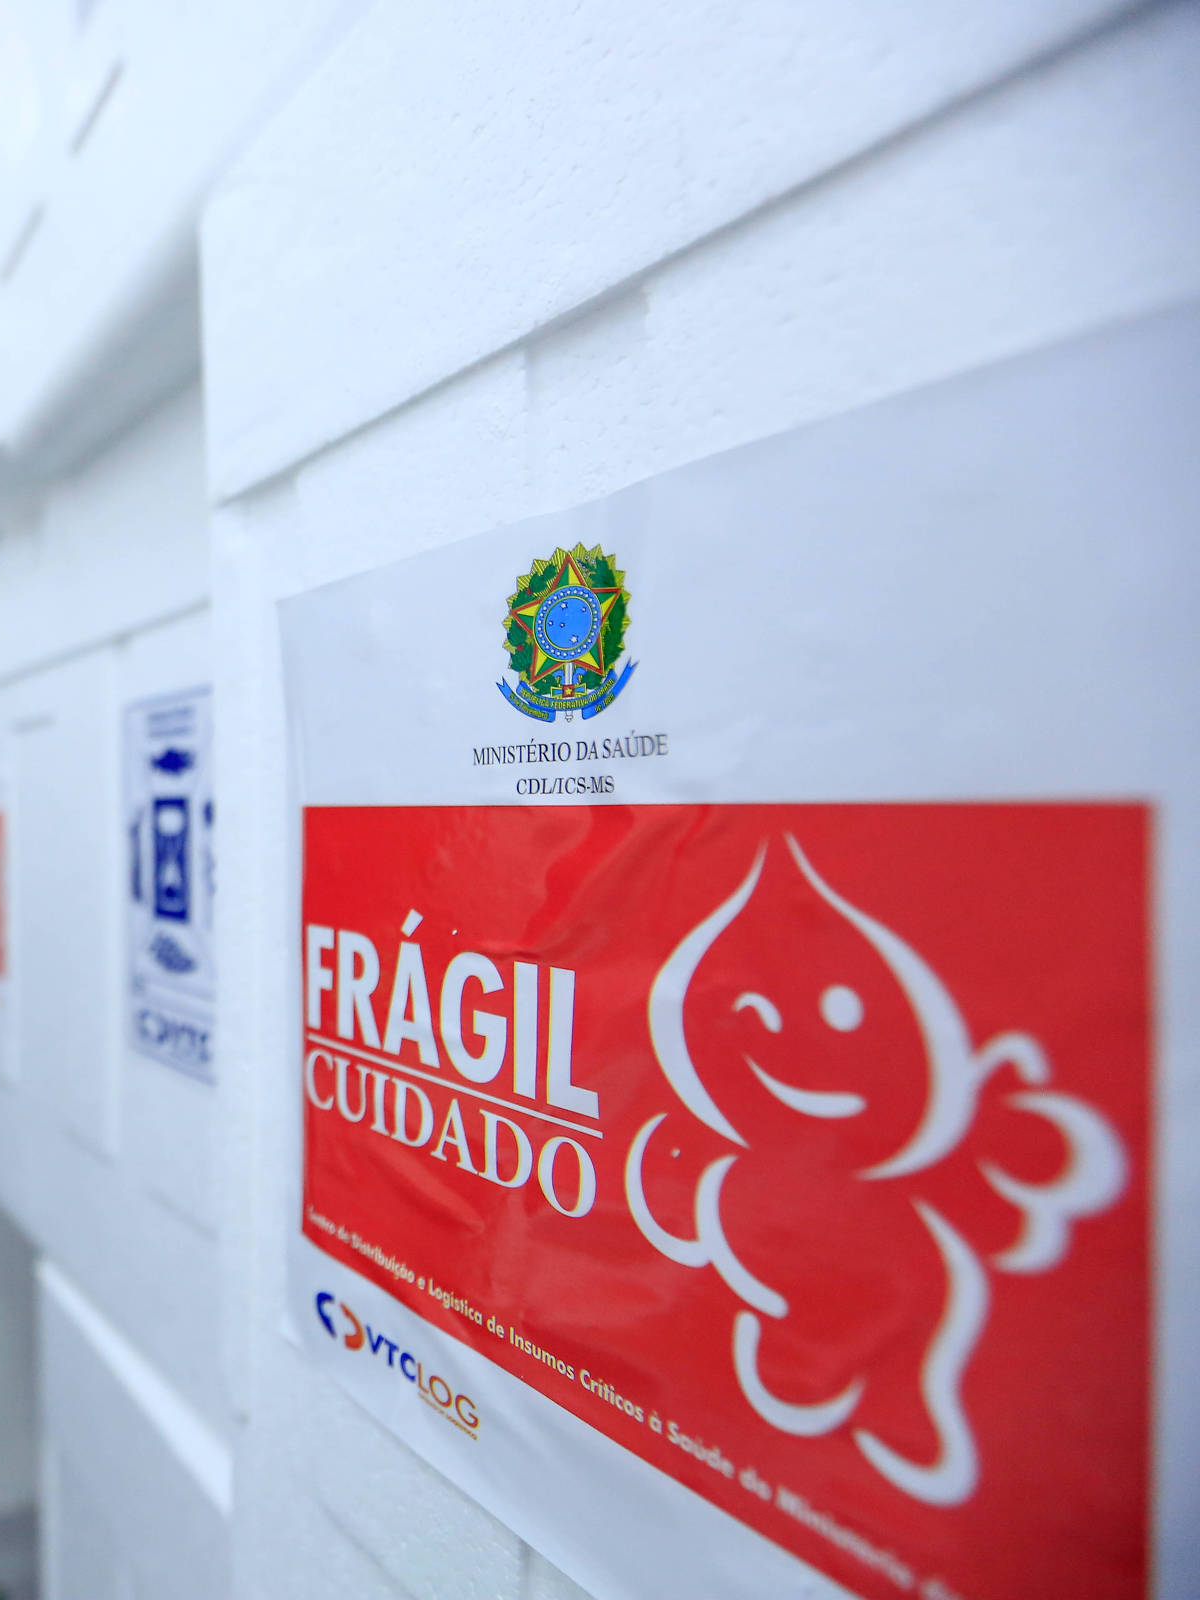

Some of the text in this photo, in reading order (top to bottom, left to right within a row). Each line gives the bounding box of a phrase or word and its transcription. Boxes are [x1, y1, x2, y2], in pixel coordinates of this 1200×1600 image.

[473, 730, 669, 766] MINISTÉRIO DA SAÚDE
[516, 775, 615, 796] CDL/ICS-MS
[306, 908, 600, 1120] FRÁGIL
[305, 1049, 596, 1218] CUIDADO
[350, 1232, 415, 1283] Distribuição
[417, 1276, 426, 1290] e
[487, 1315, 505, 1338] de
[509, 1326, 575, 1380] Insumos
[648, 1410, 662, 1434] à
[667, 1420, 734, 1479] Saúde
[366, 1324, 480, 1429] VTCLOG
